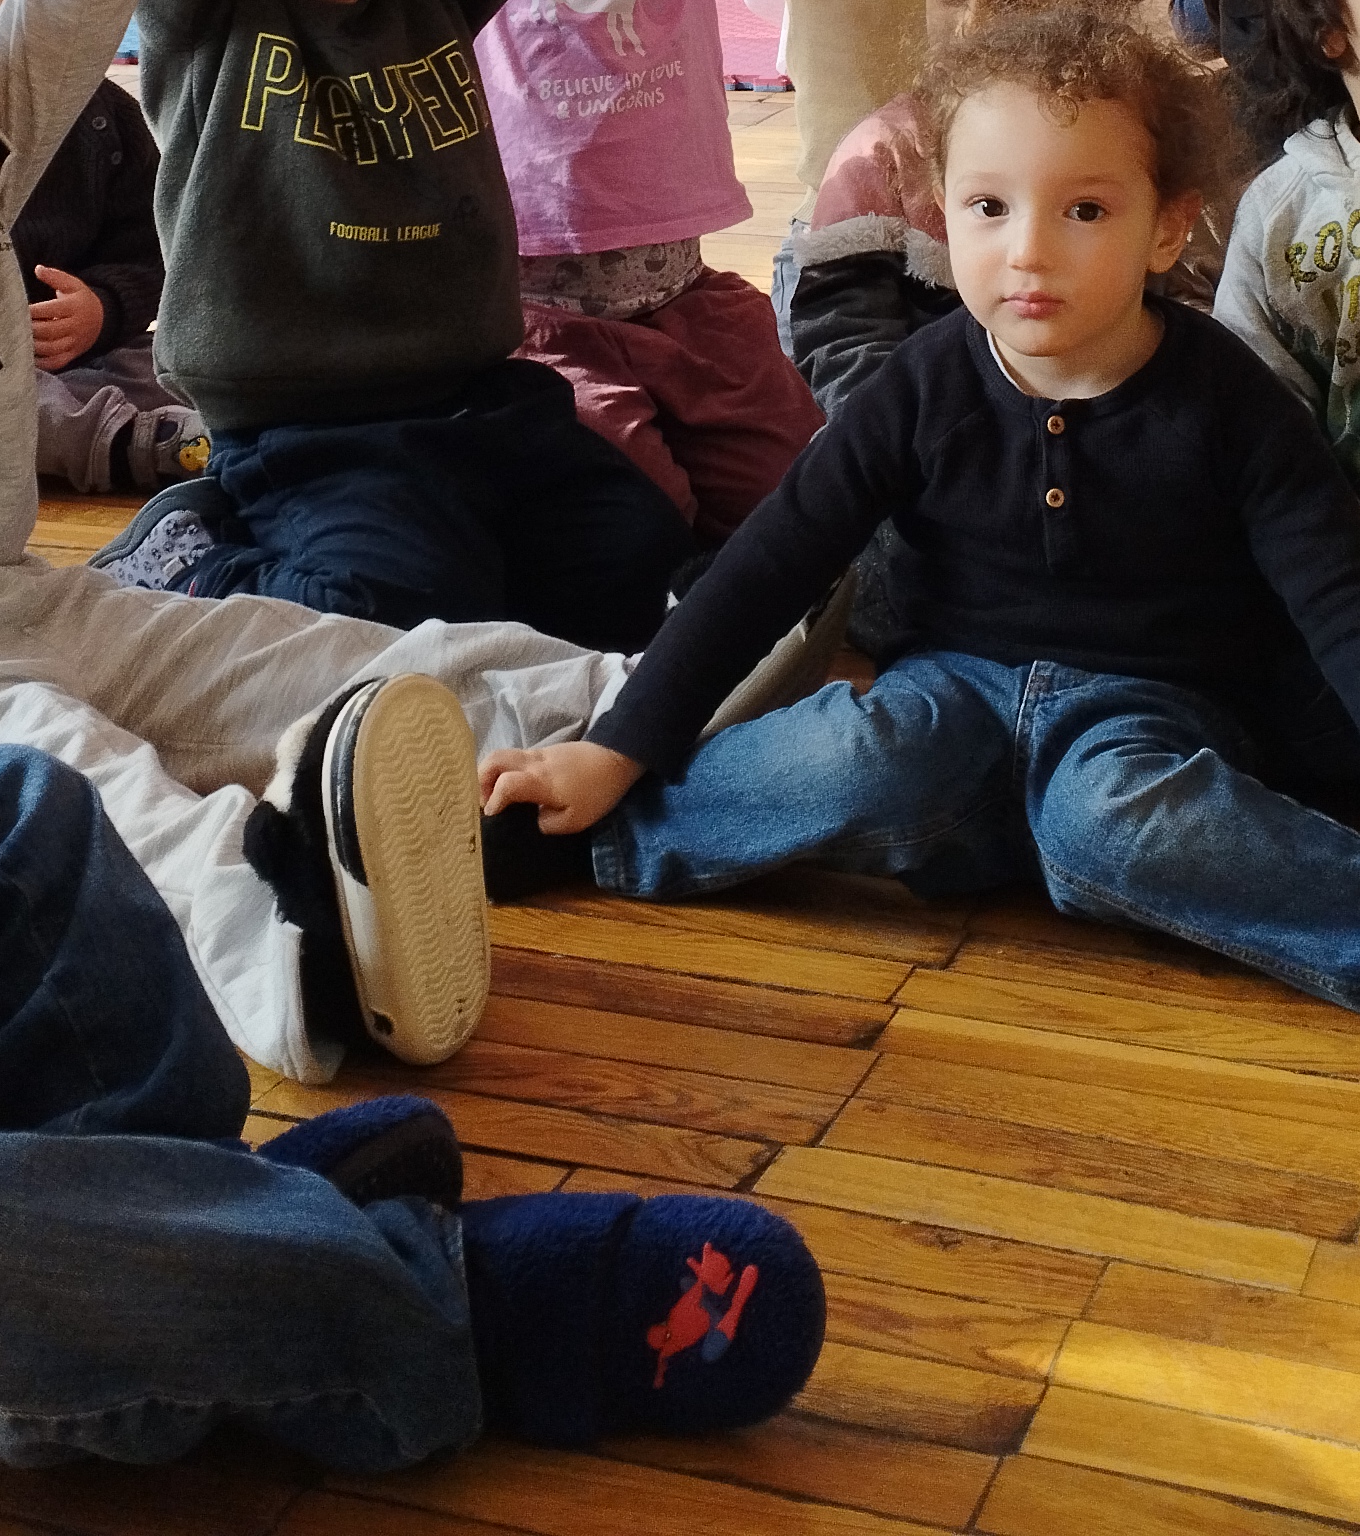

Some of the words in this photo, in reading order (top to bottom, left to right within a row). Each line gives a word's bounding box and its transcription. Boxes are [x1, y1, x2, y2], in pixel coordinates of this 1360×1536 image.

[241, 32, 490, 165] PLAYER
[539, 75, 615, 100] BELIEVE
[577, 86, 665, 118] UNICORNS
[329, 221, 390, 242] FOOTBALL
[397, 222, 442, 242] LEAGUE
